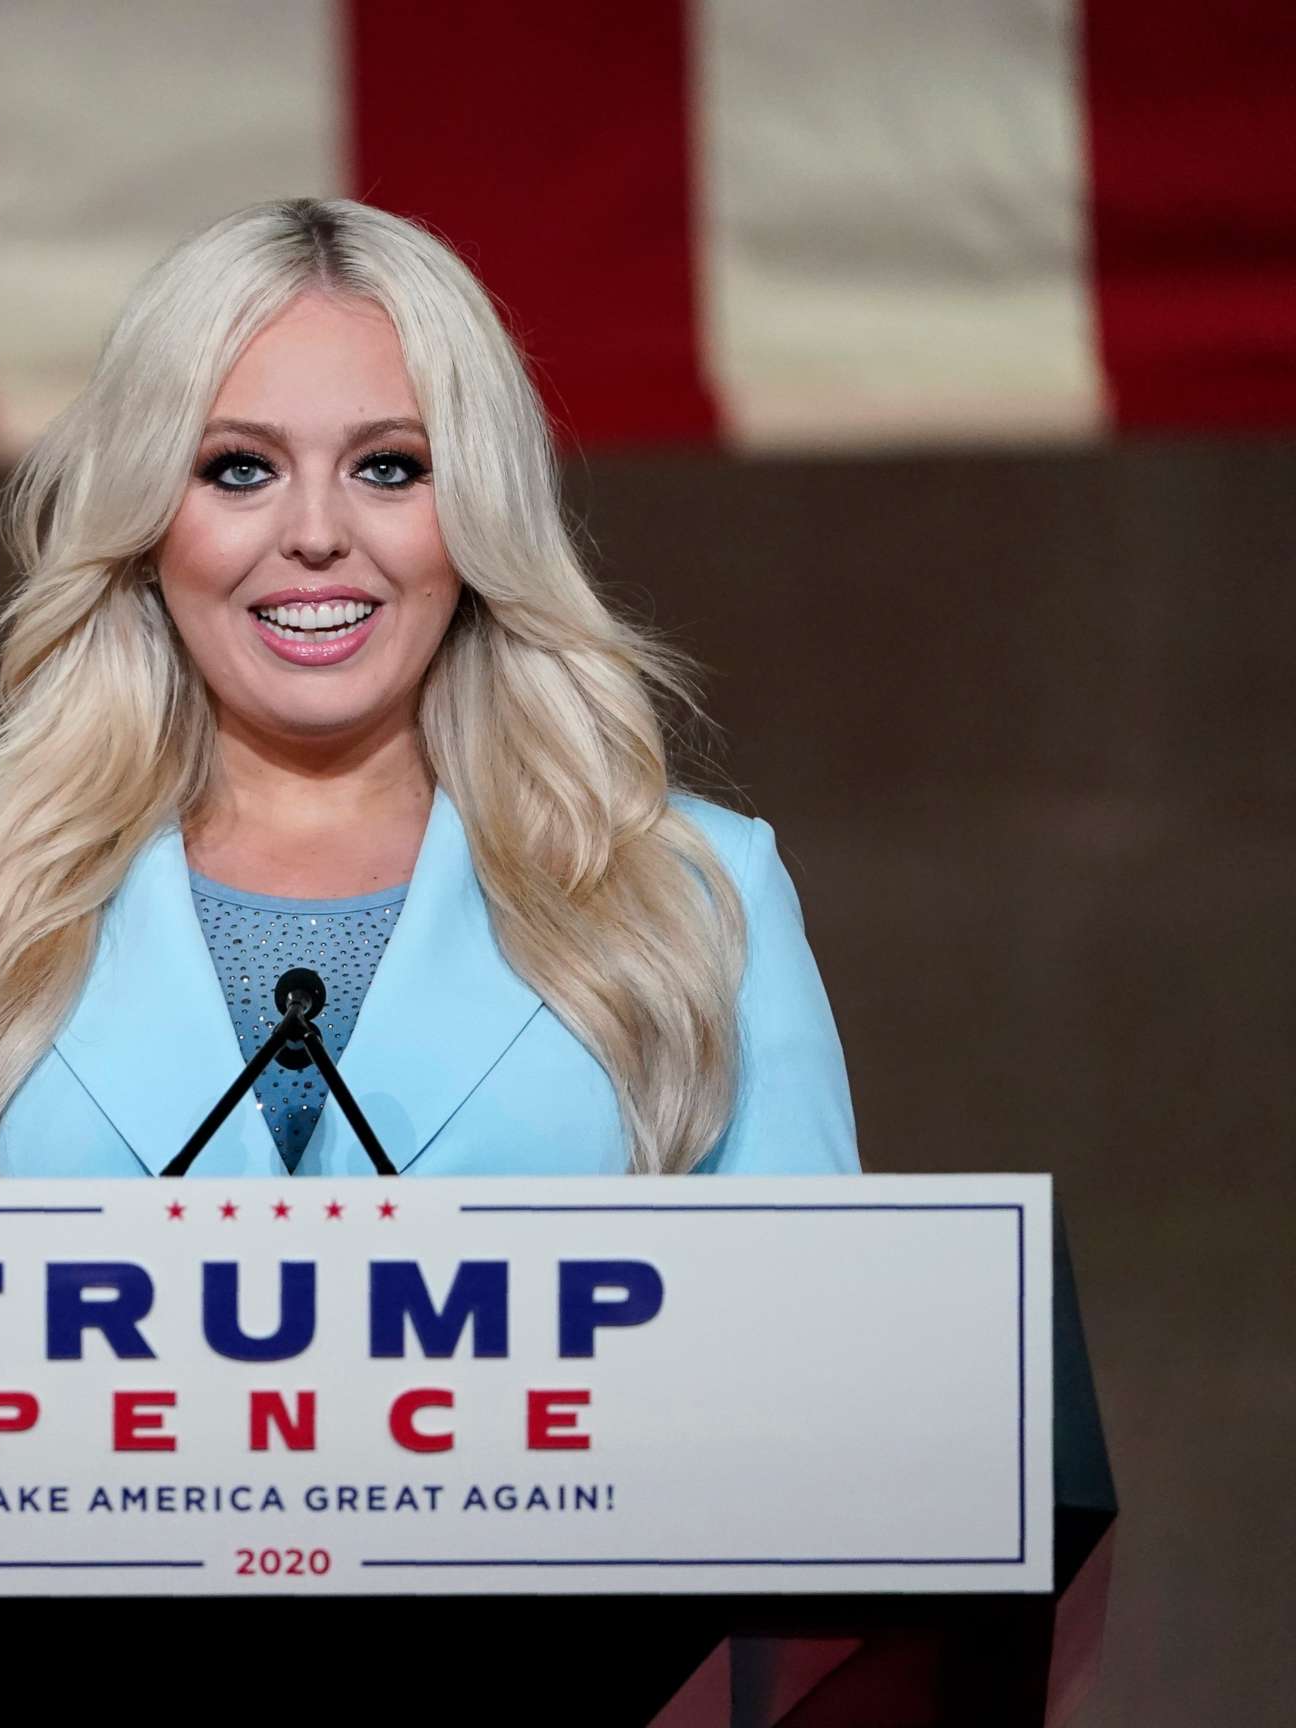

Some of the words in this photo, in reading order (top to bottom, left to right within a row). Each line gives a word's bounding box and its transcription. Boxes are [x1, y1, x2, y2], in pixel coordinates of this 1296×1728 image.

[88, 1485, 286, 1513] AMERICA
[304, 1485, 444, 1512] GREAT
[462, 1484, 614, 1511] AGAIN!
[235, 1548, 332, 1576] 2020
